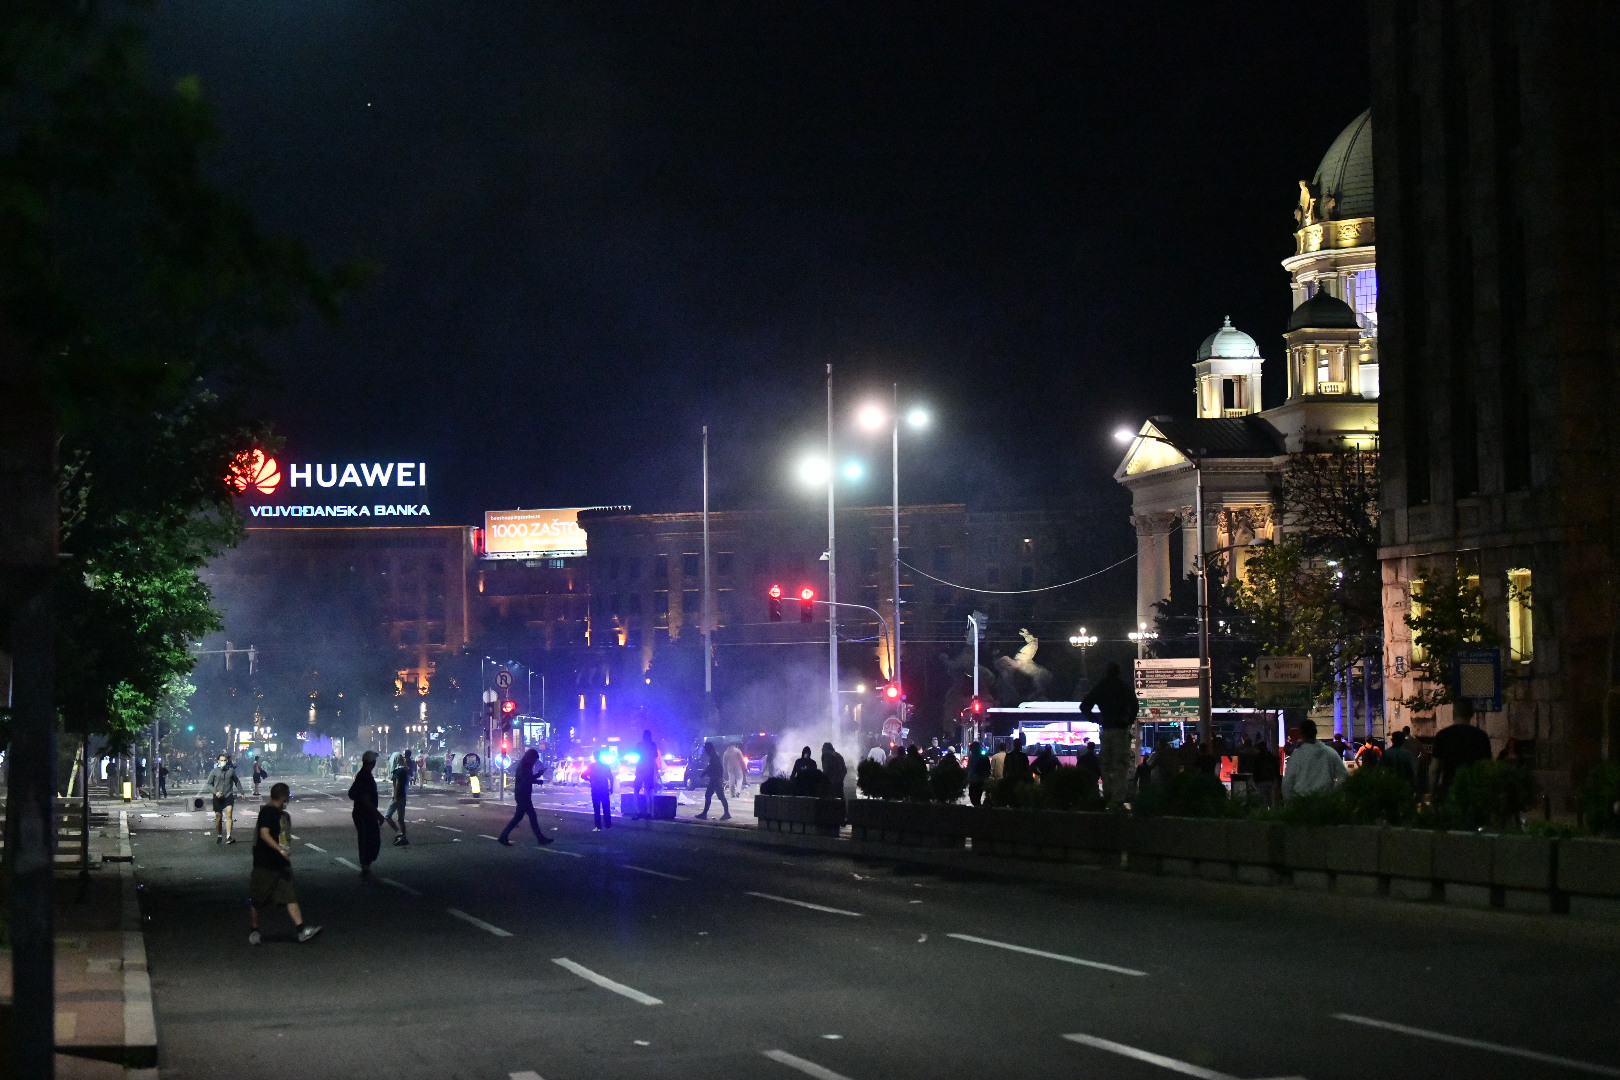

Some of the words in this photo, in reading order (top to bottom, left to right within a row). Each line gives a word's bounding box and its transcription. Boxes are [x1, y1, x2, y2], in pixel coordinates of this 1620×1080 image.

[290, 462, 426, 488] HUAWEI
[249, 505, 371, 517] VOJVOĐANSKA
[374, 504, 431, 516] BANKA
[491, 523, 528, 538] 1000
[1274, 661, 1303, 671] Центар
